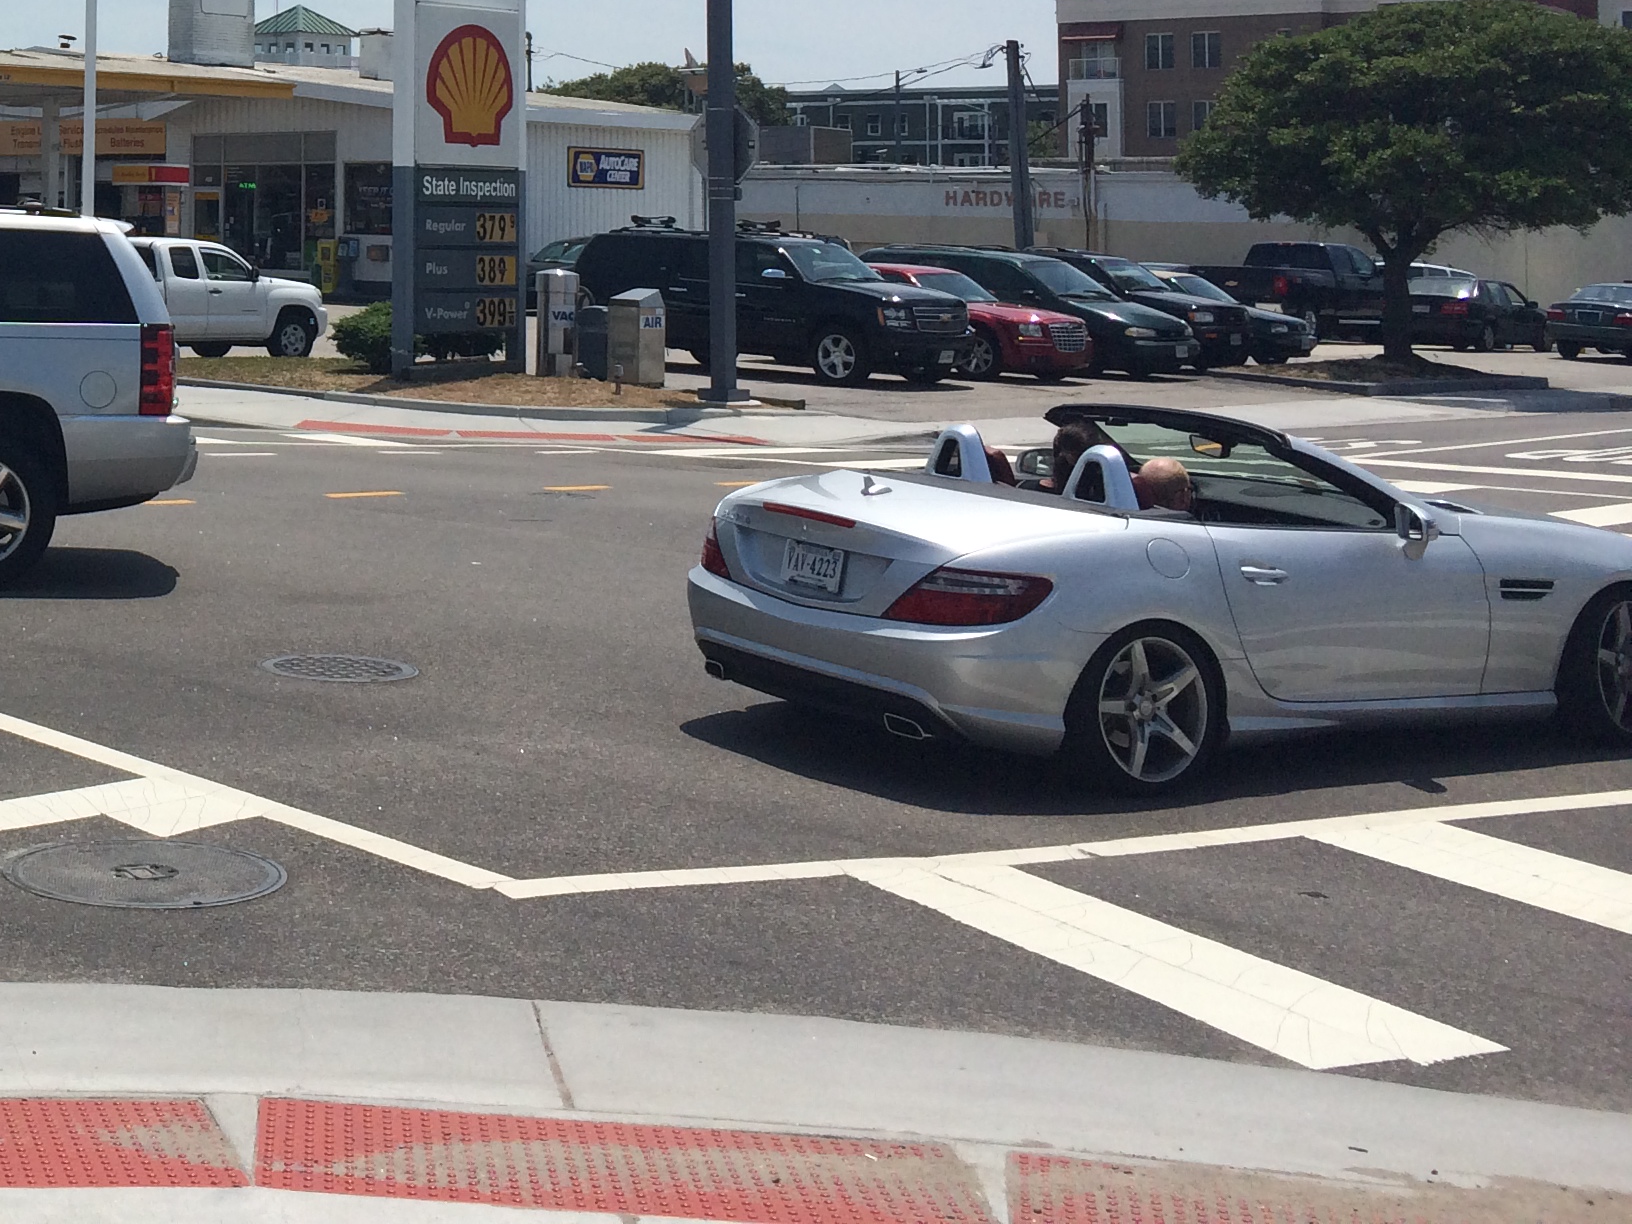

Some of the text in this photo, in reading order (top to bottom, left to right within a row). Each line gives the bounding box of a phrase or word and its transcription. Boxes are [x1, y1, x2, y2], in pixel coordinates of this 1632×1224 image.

[238, 181, 257, 190] ATM
[423, 176, 516, 201] State Inspection
[425, 219, 466, 234] Regular
[425, 262, 448, 275] Plus
[425, 307, 468, 320] V-Power
[643, 316, 662, 329] AIR
